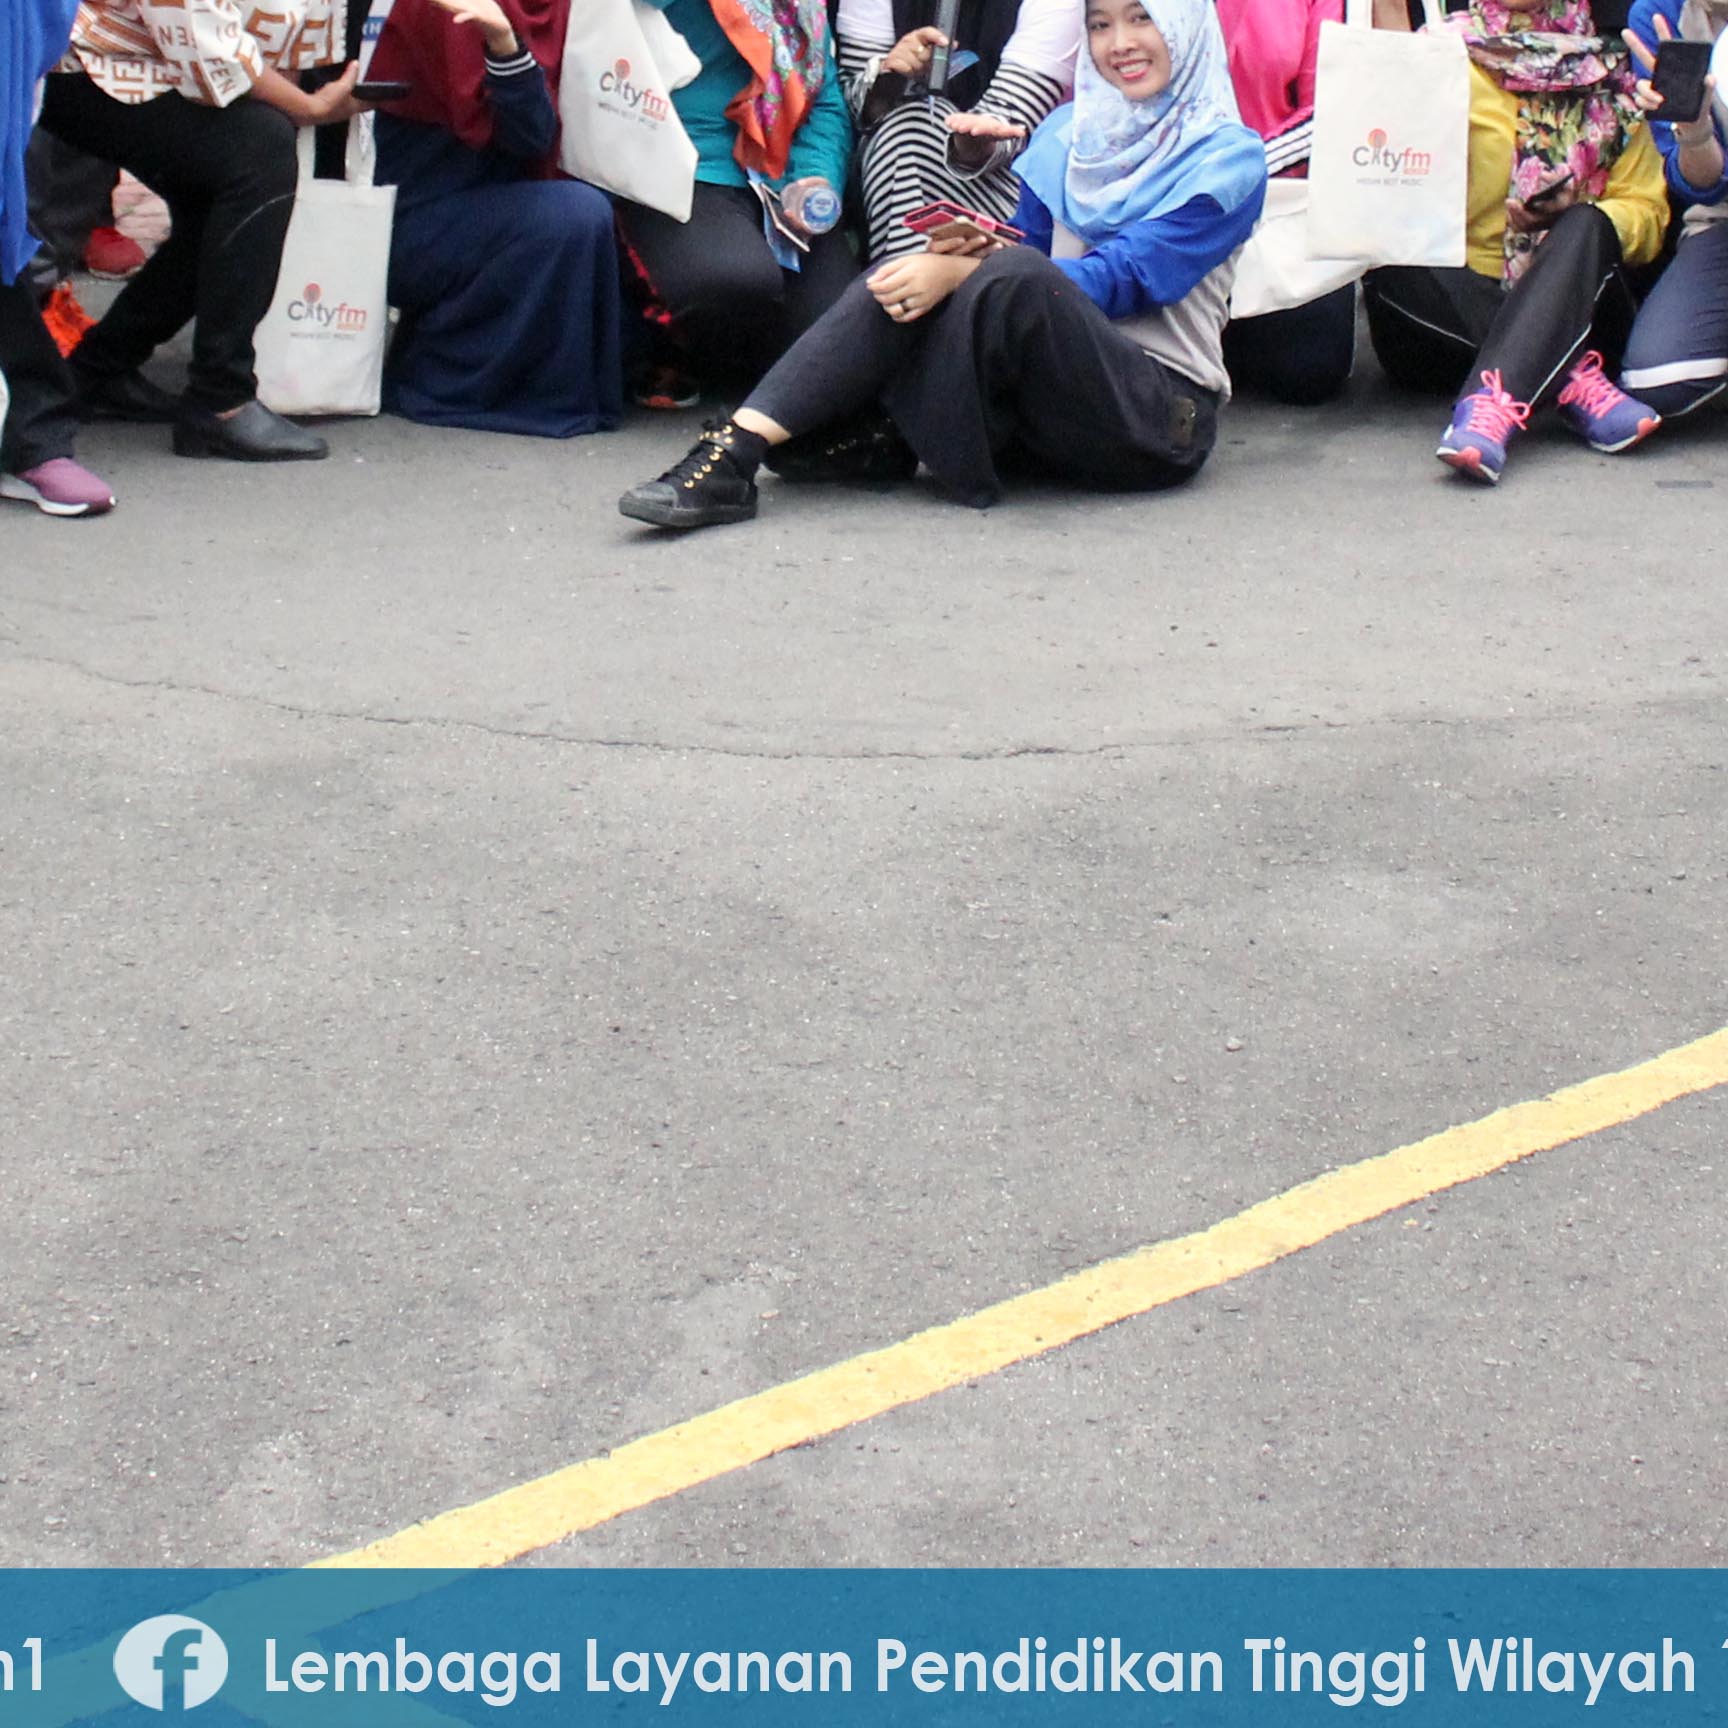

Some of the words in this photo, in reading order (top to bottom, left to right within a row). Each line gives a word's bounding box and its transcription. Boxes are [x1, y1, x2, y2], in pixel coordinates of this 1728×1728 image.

[599, 58, 670, 114] Cityfm
[1352, 128, 1431, 173] Cityfm
[287, 283, 366, 327] Cityfm
